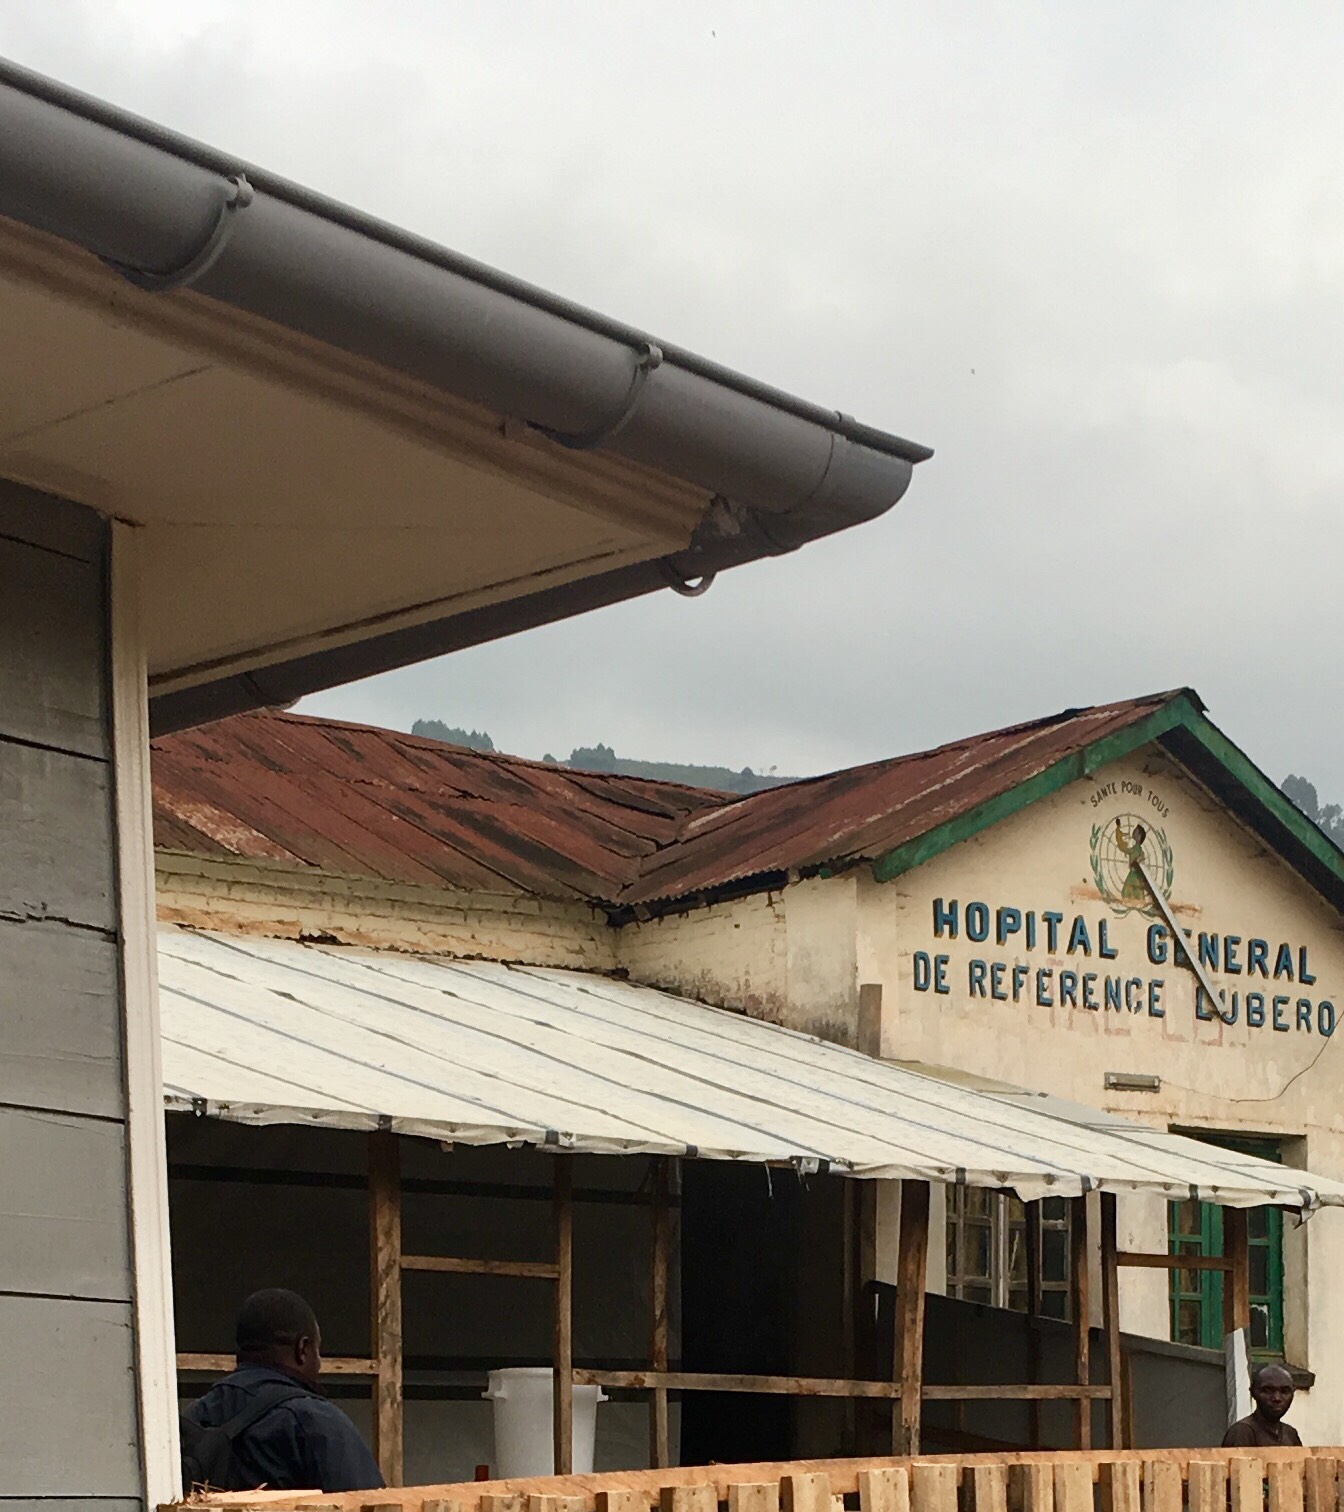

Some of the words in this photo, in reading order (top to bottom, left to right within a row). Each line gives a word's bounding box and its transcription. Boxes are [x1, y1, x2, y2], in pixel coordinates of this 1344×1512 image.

[1090, 782, 1117, 808] SANTE
[1121, 780, 1143, 797] POUR
[1147, 790, 1169, 818] TOUS
[933, 898, 1119, 960] HOPITAL
[1147, 923, 1317, 986] GENERAL
[913, 951, 950, 994] DE
[969, 959, 1165, 1018] REFERENCE
[1196, 985, 1335, 1038] LUBERO
